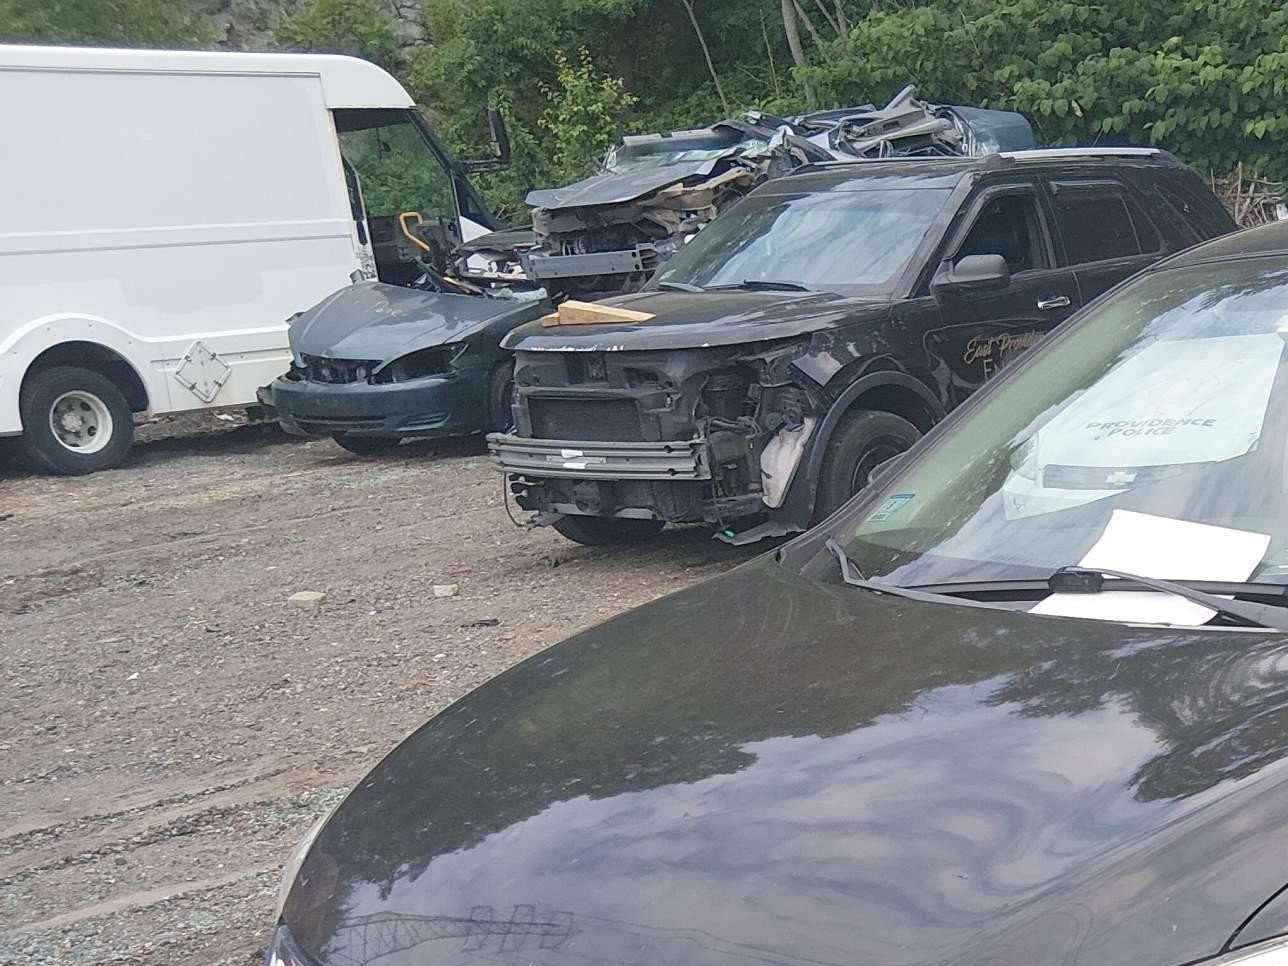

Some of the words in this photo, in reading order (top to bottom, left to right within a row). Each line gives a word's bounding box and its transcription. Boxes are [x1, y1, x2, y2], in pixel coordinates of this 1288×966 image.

[964, 336, 995, 364] East
[1085, 418, 1217, 430] PROVIDENCE
[1107, 427, 1176, 437] POLICE
